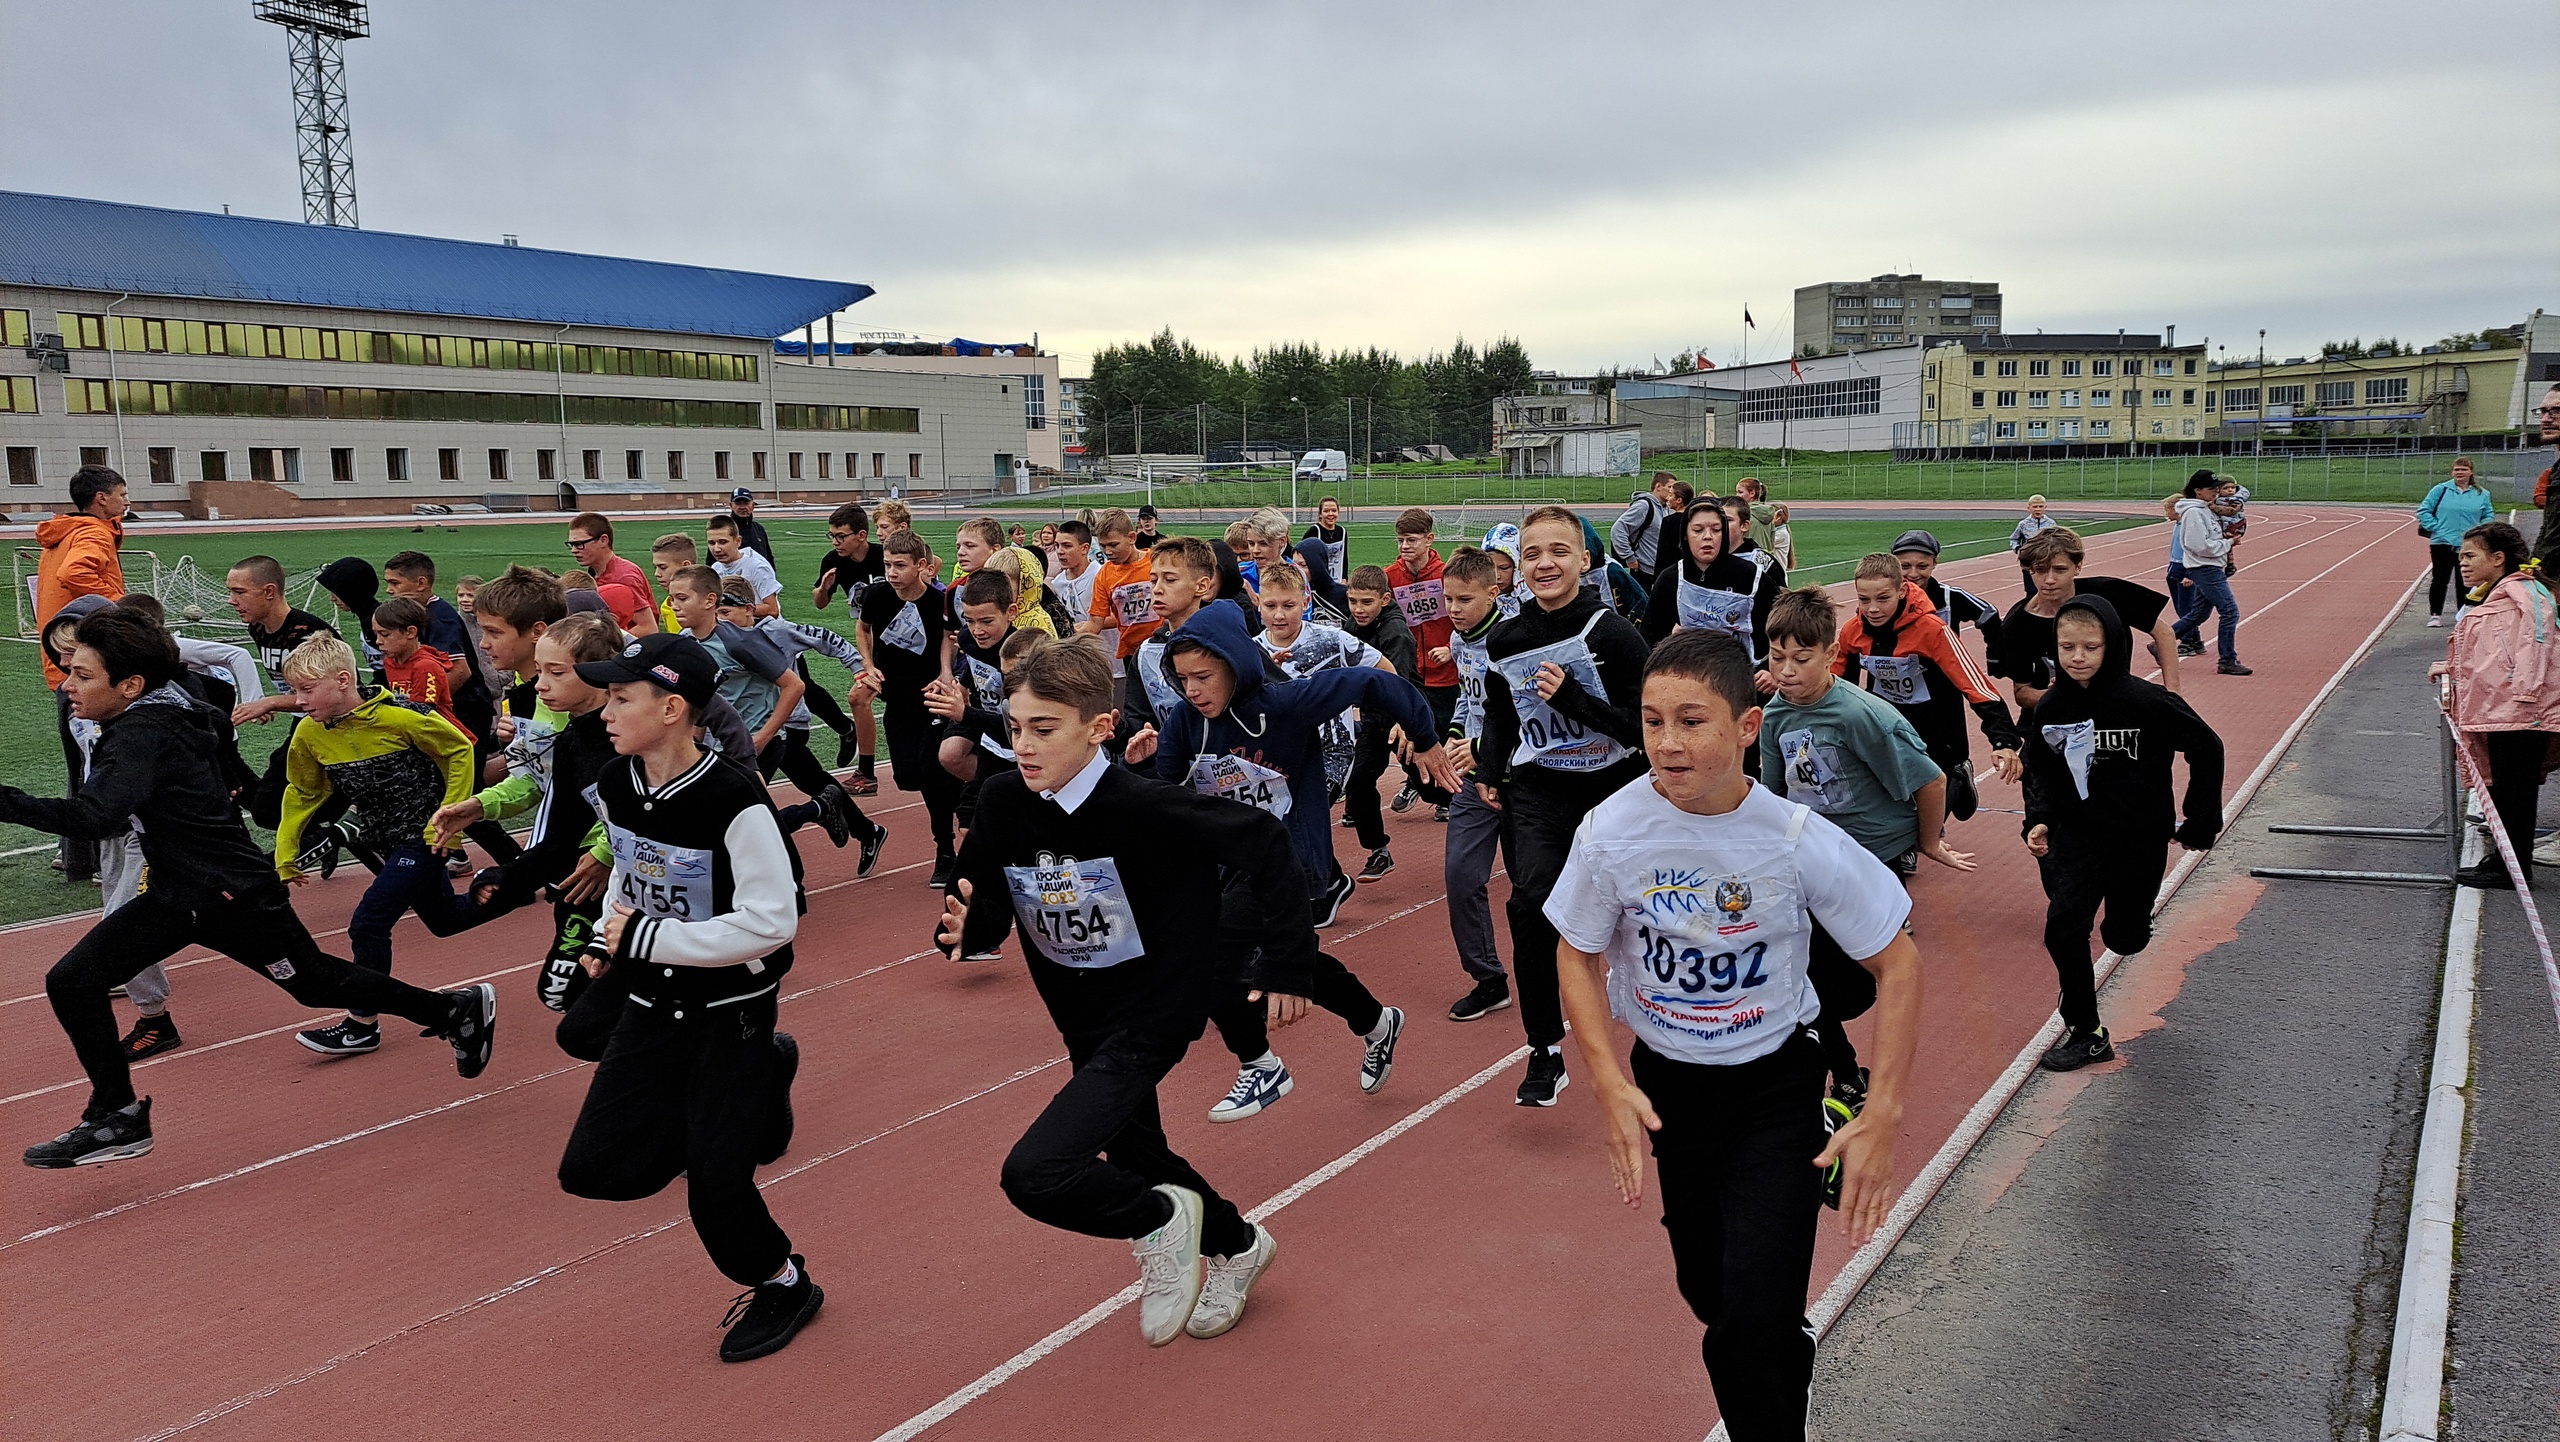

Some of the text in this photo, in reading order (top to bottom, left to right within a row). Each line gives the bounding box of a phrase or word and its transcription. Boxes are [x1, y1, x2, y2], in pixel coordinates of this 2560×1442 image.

[1124, 599, 1151, 616] 4797
[1407, 597, 1438, 616] 4858
[1589, 746, 1609, 755] 2016
[1533, 757, 1587, 767] АСНОЯРСКИЙ
[1216, 771, 1248, 788] 2023
[1035, 871, 1062, 882] КРОСС
[1038, 879, 1074, 892] НАЦИИ
[621, 872, 691, 918] 4755
[1040, 891, 1077, 905] 2023
[1036, 904, 1111, 944] 4754
[1071, 954, 1093, 963] КРАЙ
[1638, 924, 1770, 994] 10392
[1731, 1006, 1765, 1025] 2016
